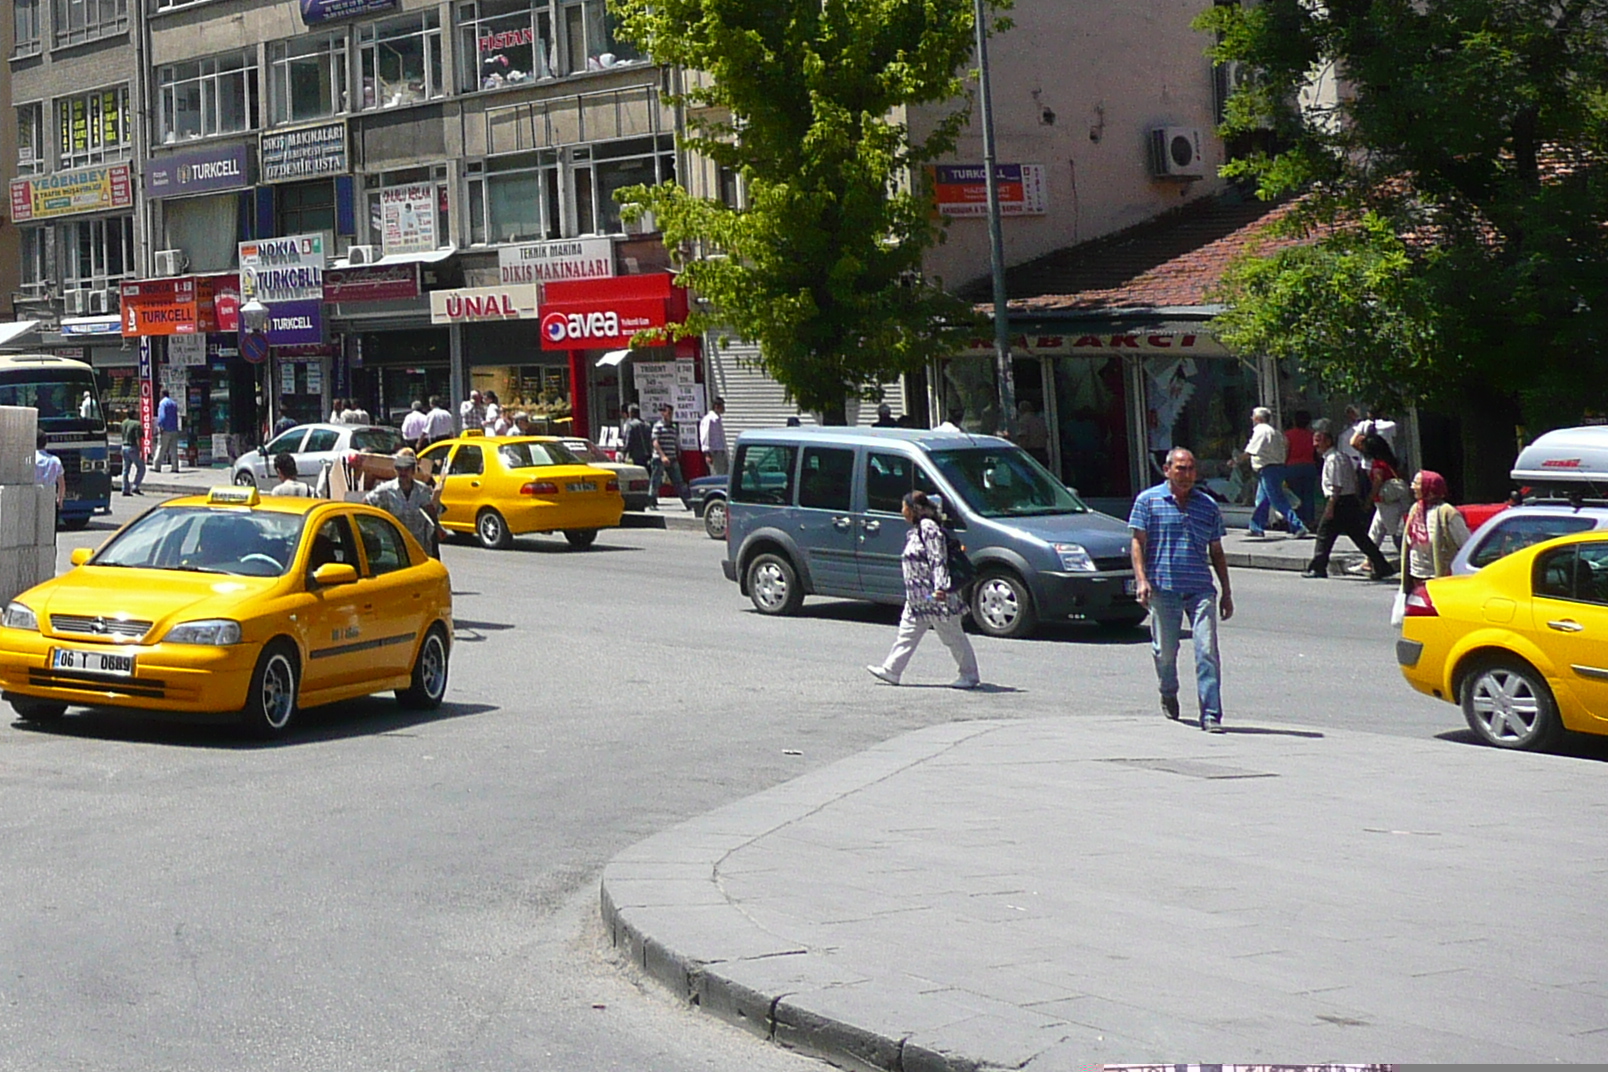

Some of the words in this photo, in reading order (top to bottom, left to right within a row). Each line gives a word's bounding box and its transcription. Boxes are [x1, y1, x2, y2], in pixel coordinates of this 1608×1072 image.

[192, 159, 240, 180] TURKCELL
[951, 168, 1006, 180] TURKCL
[258, 239, 299, 257] NOKIA
[519, 244, 547, 260] TEKNİK
[256, 267, 322, 292] TURKCELL
[446, 292, 517, 319] ÜNAL
[141, 308, 194, 324] TURKCELL
[273, 316, 313, 331] TURKCELL
[568, 310, 618, 340] avea
[60, 653, 75, 667] 06
[81, 653, 89, 668] T
